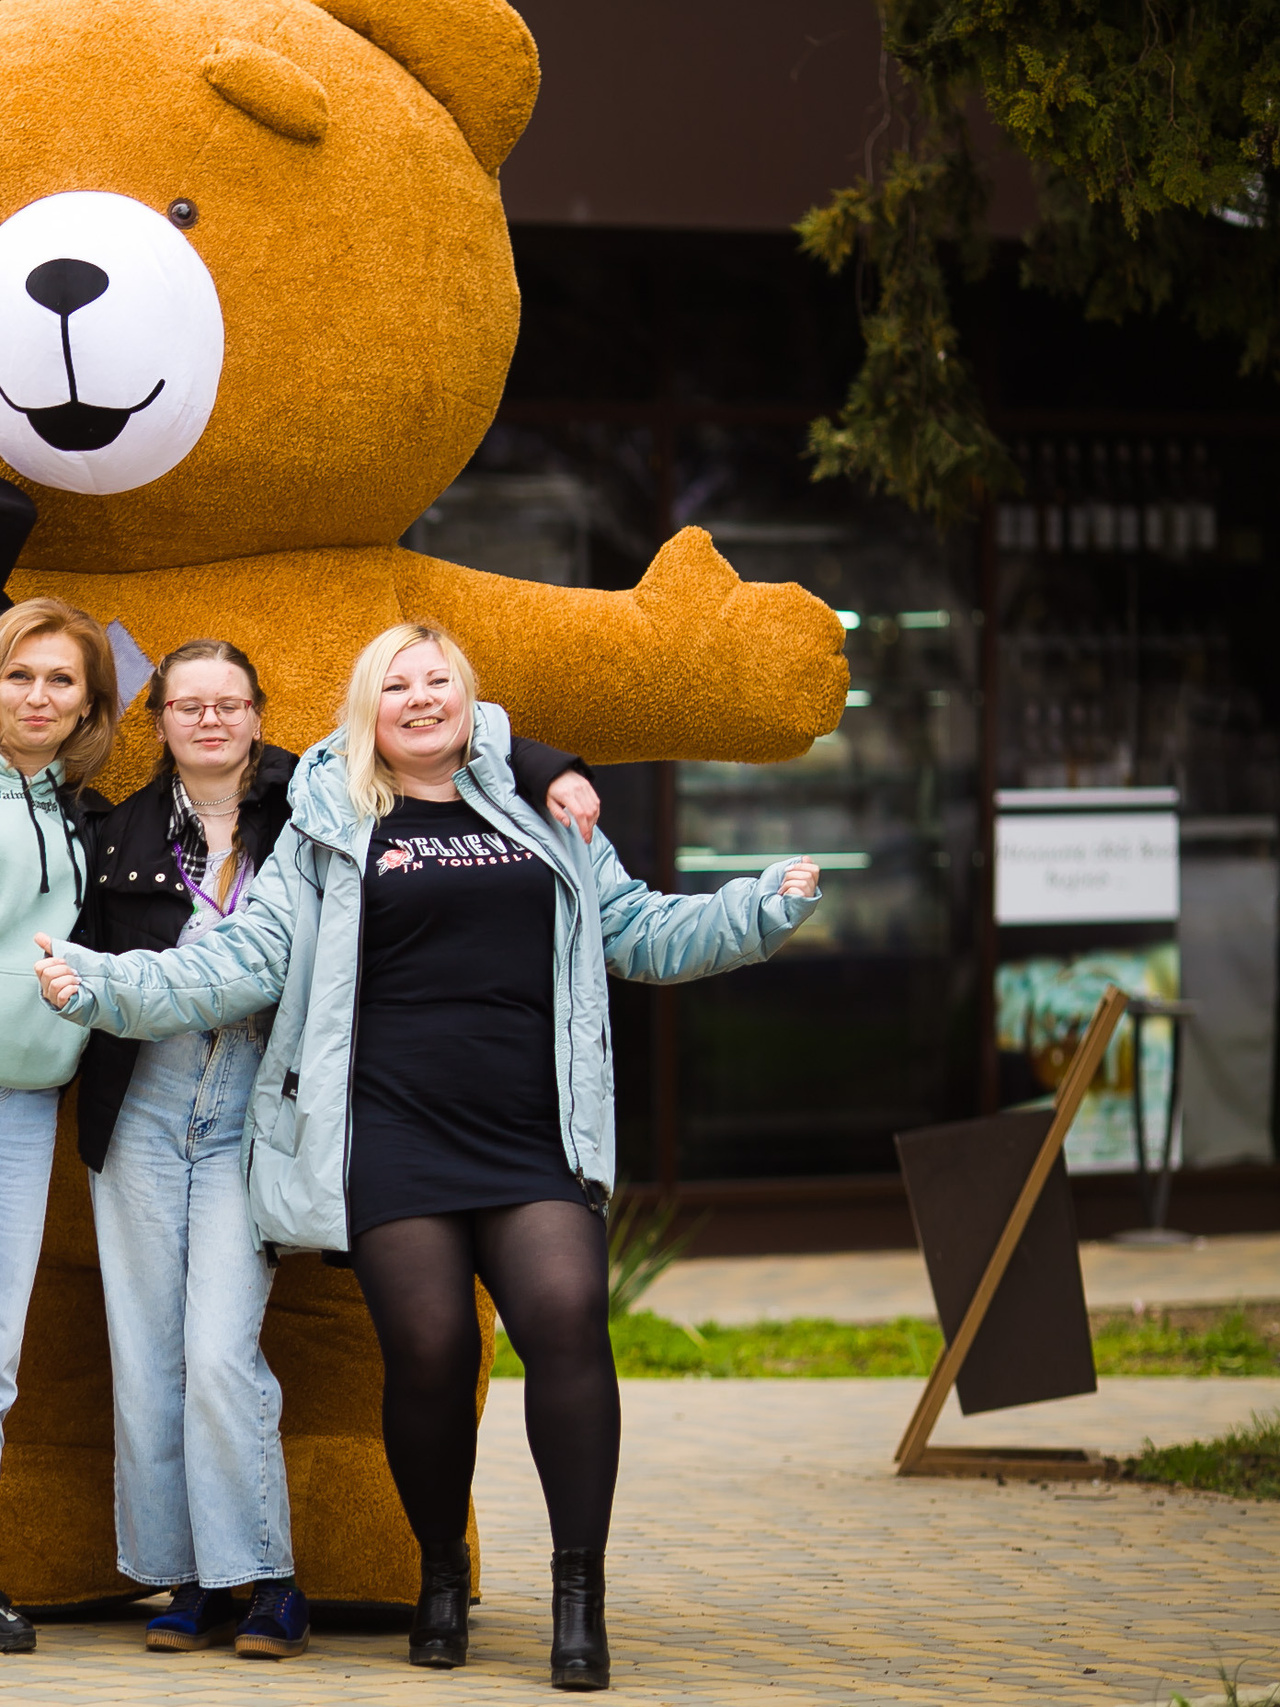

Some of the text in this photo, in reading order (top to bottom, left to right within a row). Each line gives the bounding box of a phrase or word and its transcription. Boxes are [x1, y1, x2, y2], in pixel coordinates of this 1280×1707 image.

[388, 832, 526, 858] ELIEV
[403, 852, 533, 874] IN YOURSELF
